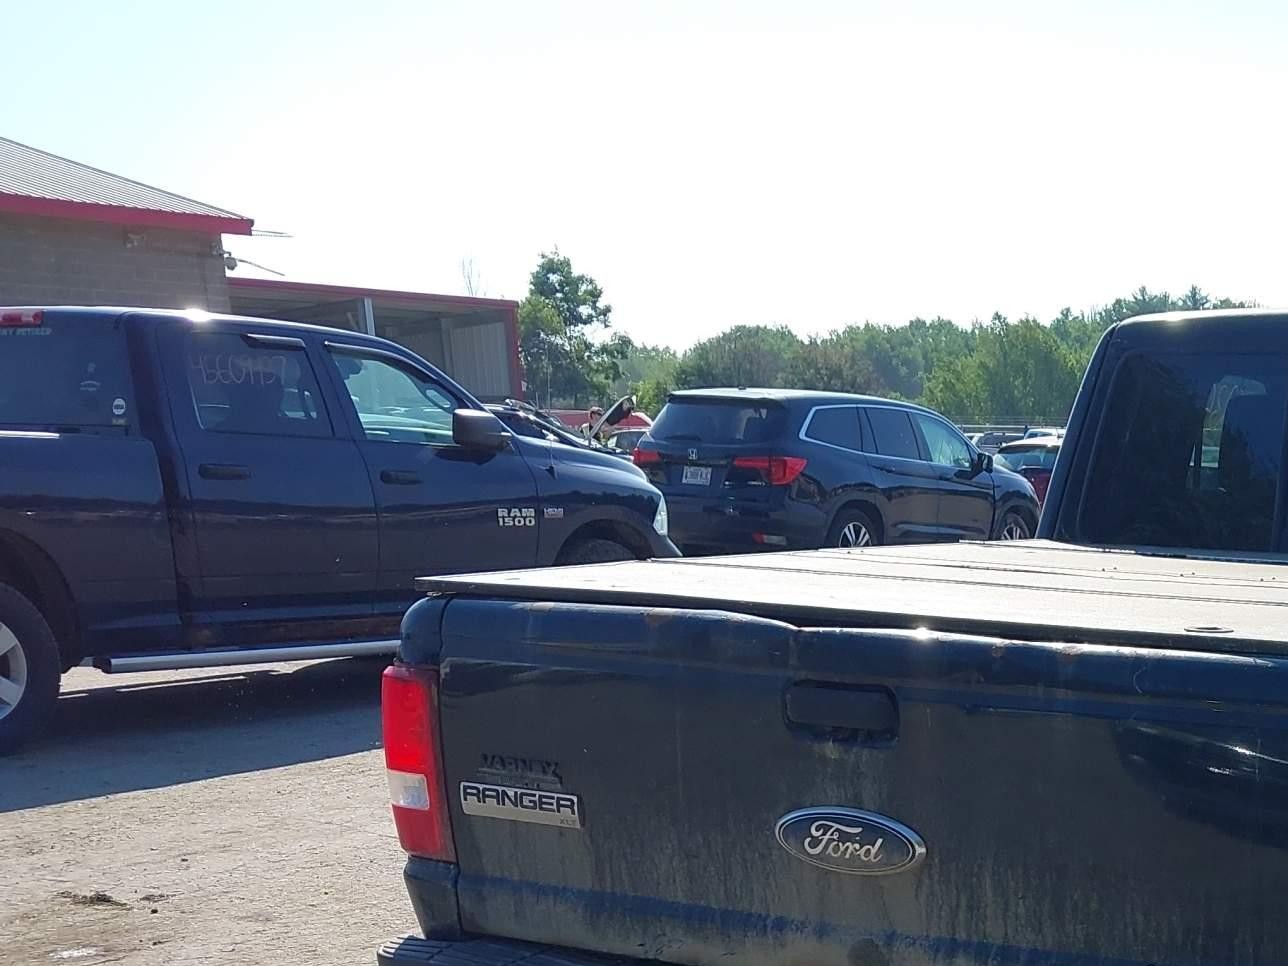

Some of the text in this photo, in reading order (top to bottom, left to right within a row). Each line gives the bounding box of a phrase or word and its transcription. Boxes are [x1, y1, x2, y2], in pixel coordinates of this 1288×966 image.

[498, 508, 535, 517] RAM
[498, 517, 535, 527] 1500
[463, 785, 576, 815] RANGER
[804, 820, 884, 863] Ford
